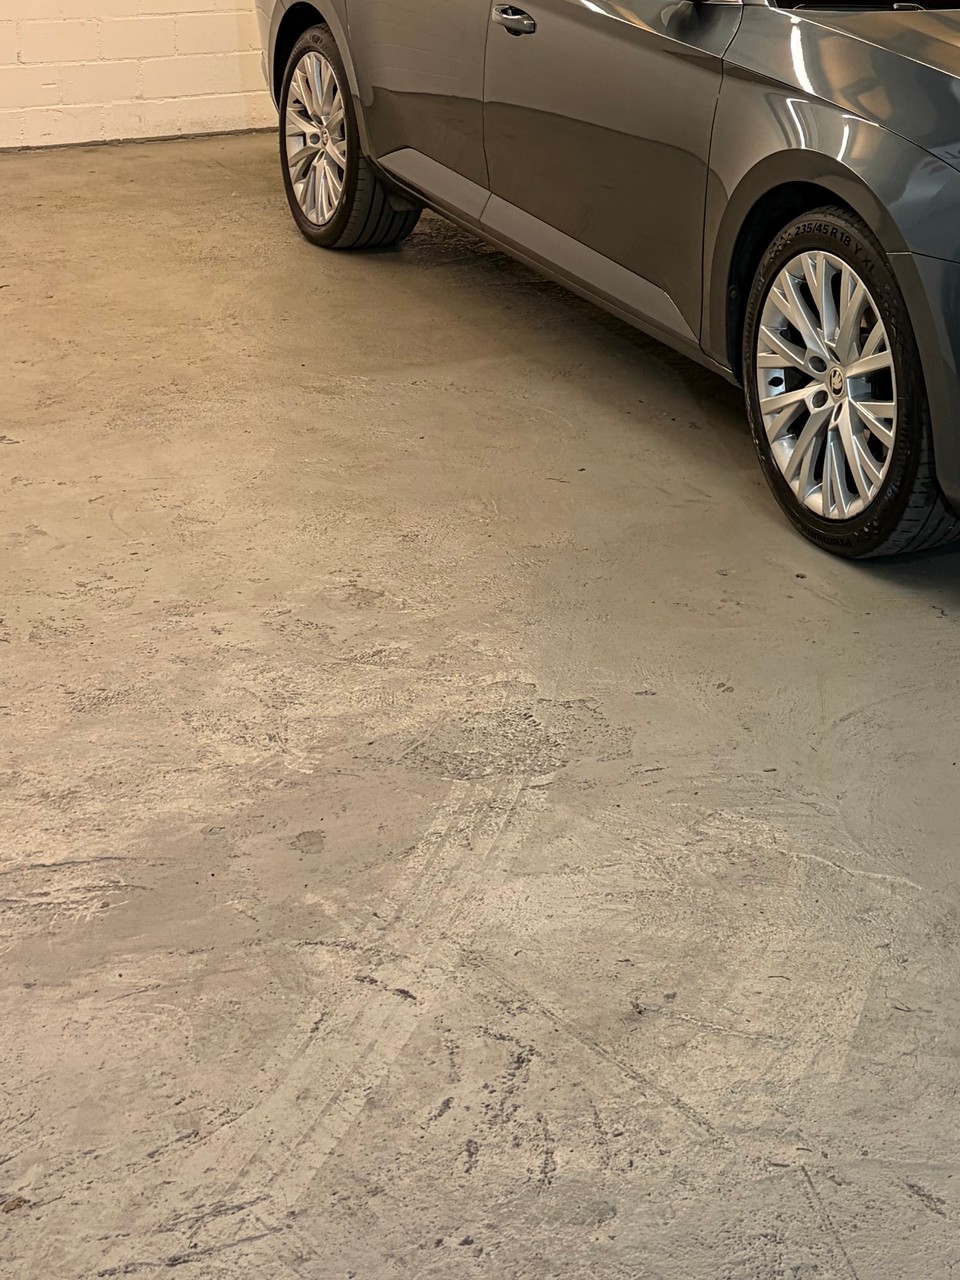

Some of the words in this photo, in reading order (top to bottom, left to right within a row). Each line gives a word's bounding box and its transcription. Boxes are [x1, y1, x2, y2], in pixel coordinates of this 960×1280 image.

[795, 222, 829, 236] 235/45
[830, 227, 838, 239] R
[840, 231, 851, 247] 18
